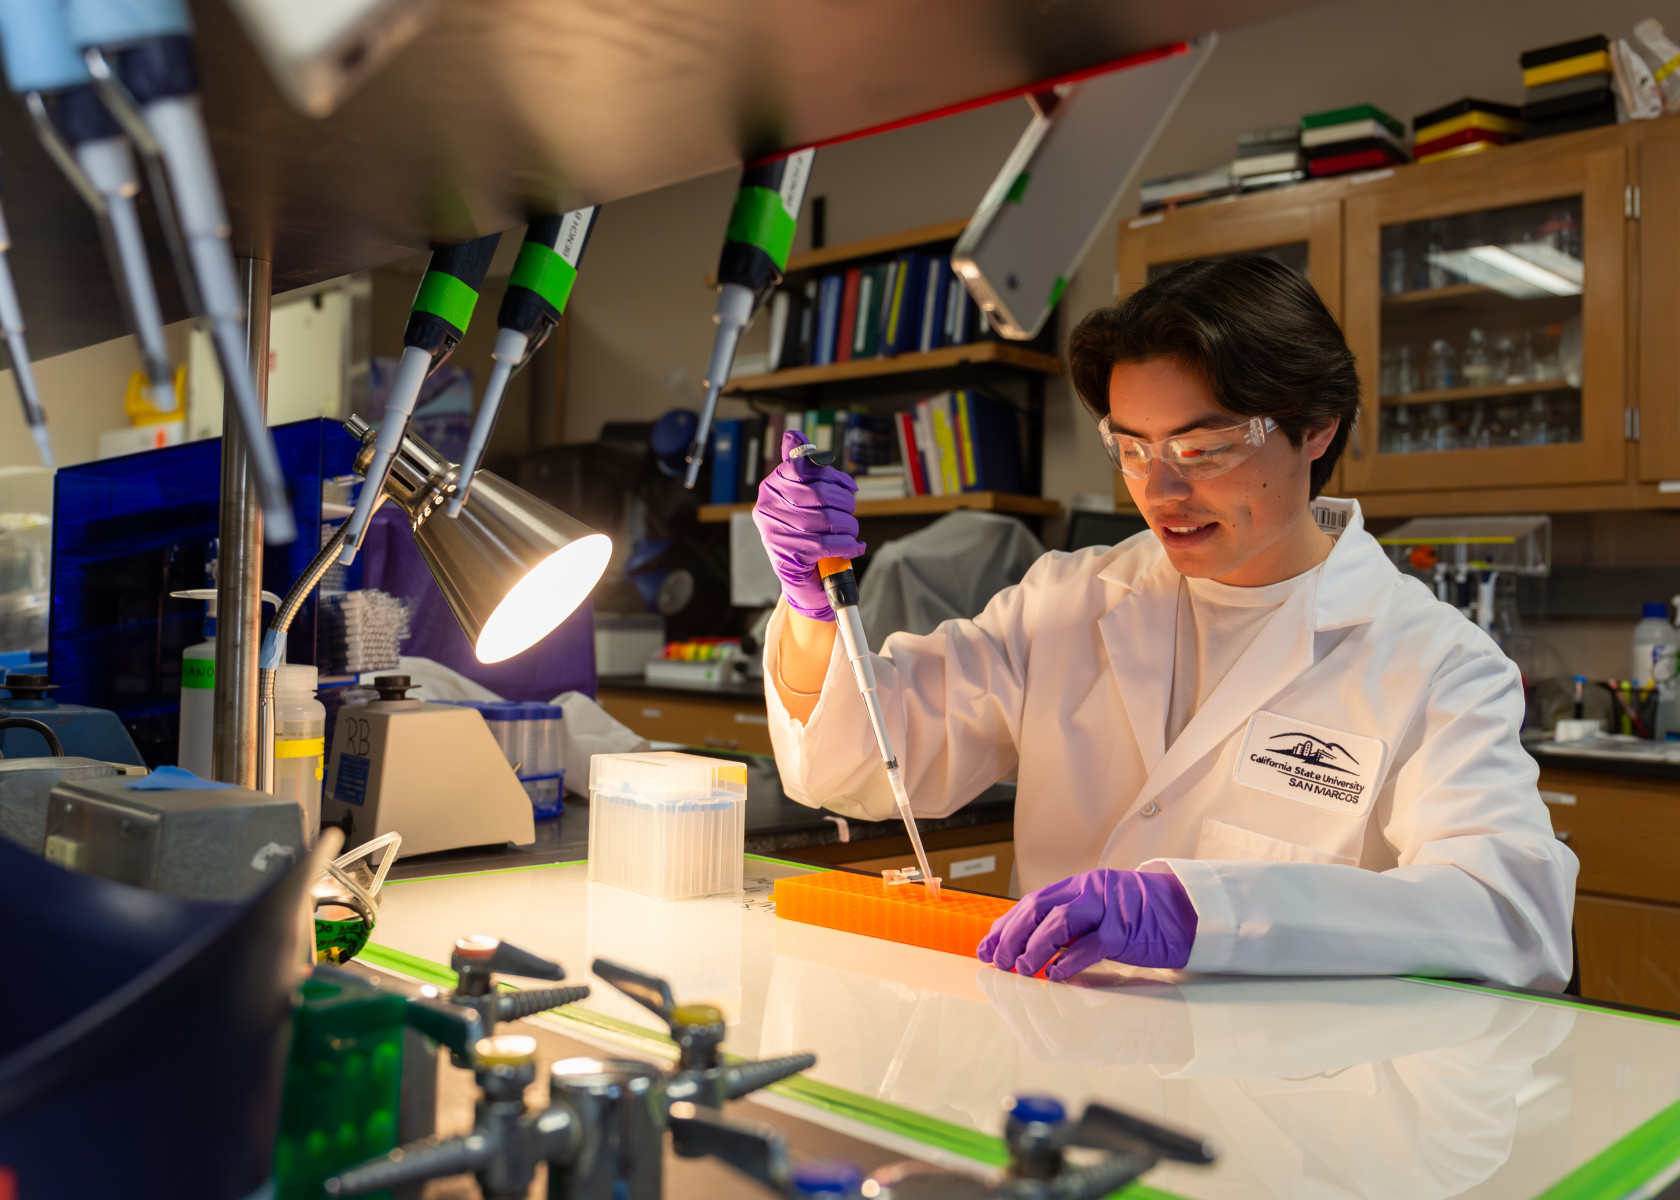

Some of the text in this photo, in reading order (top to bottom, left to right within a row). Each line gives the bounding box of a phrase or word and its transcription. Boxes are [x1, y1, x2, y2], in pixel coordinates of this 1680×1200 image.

[562, 221, 579, 258] BENCH
[185, 665, 215, 678] ANO
[345, 717, 370, 756] RB
[1250, 753, 1365, 792] California State University
[1288, 778, 1360, 804] SAN MARCOS
